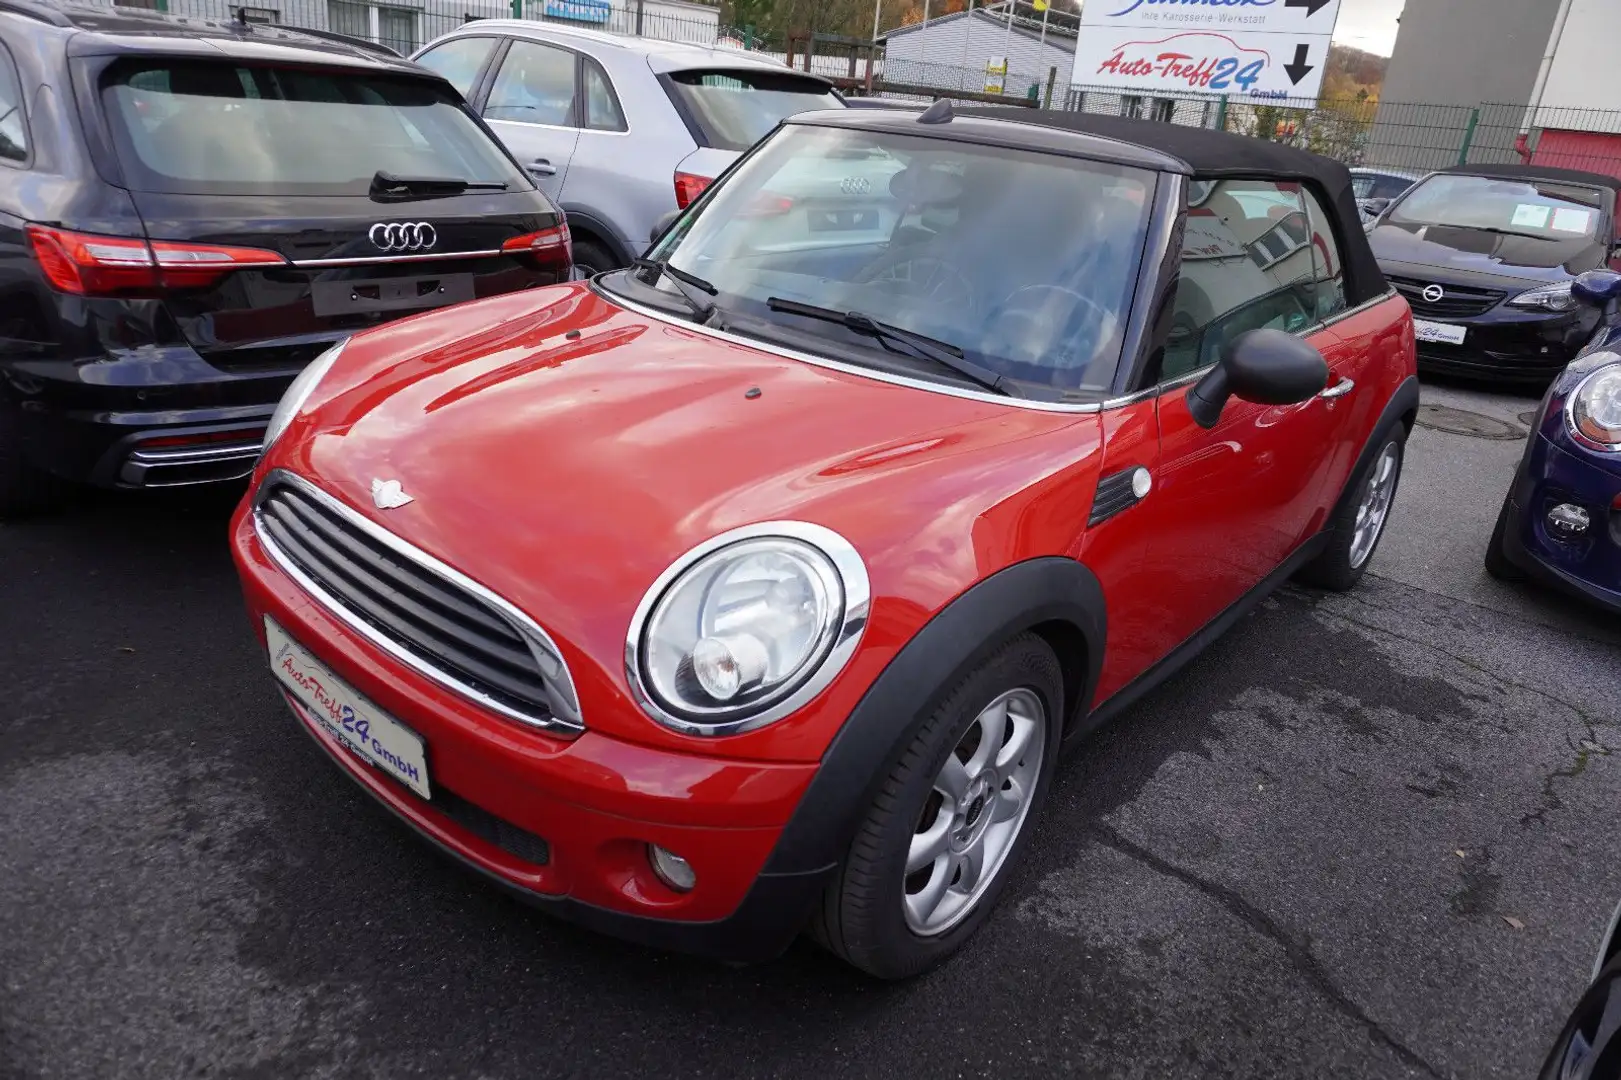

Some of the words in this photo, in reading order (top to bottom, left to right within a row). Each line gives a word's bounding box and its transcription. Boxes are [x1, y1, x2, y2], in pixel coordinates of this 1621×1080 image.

[1141, 12, 1159, 20] Ihre
[1162, 12, 1266, 24] Karosserie-Werkstatt
[1250, 88, 1288, 99] GmbH
[372, 738, 420, 782] GmbH
